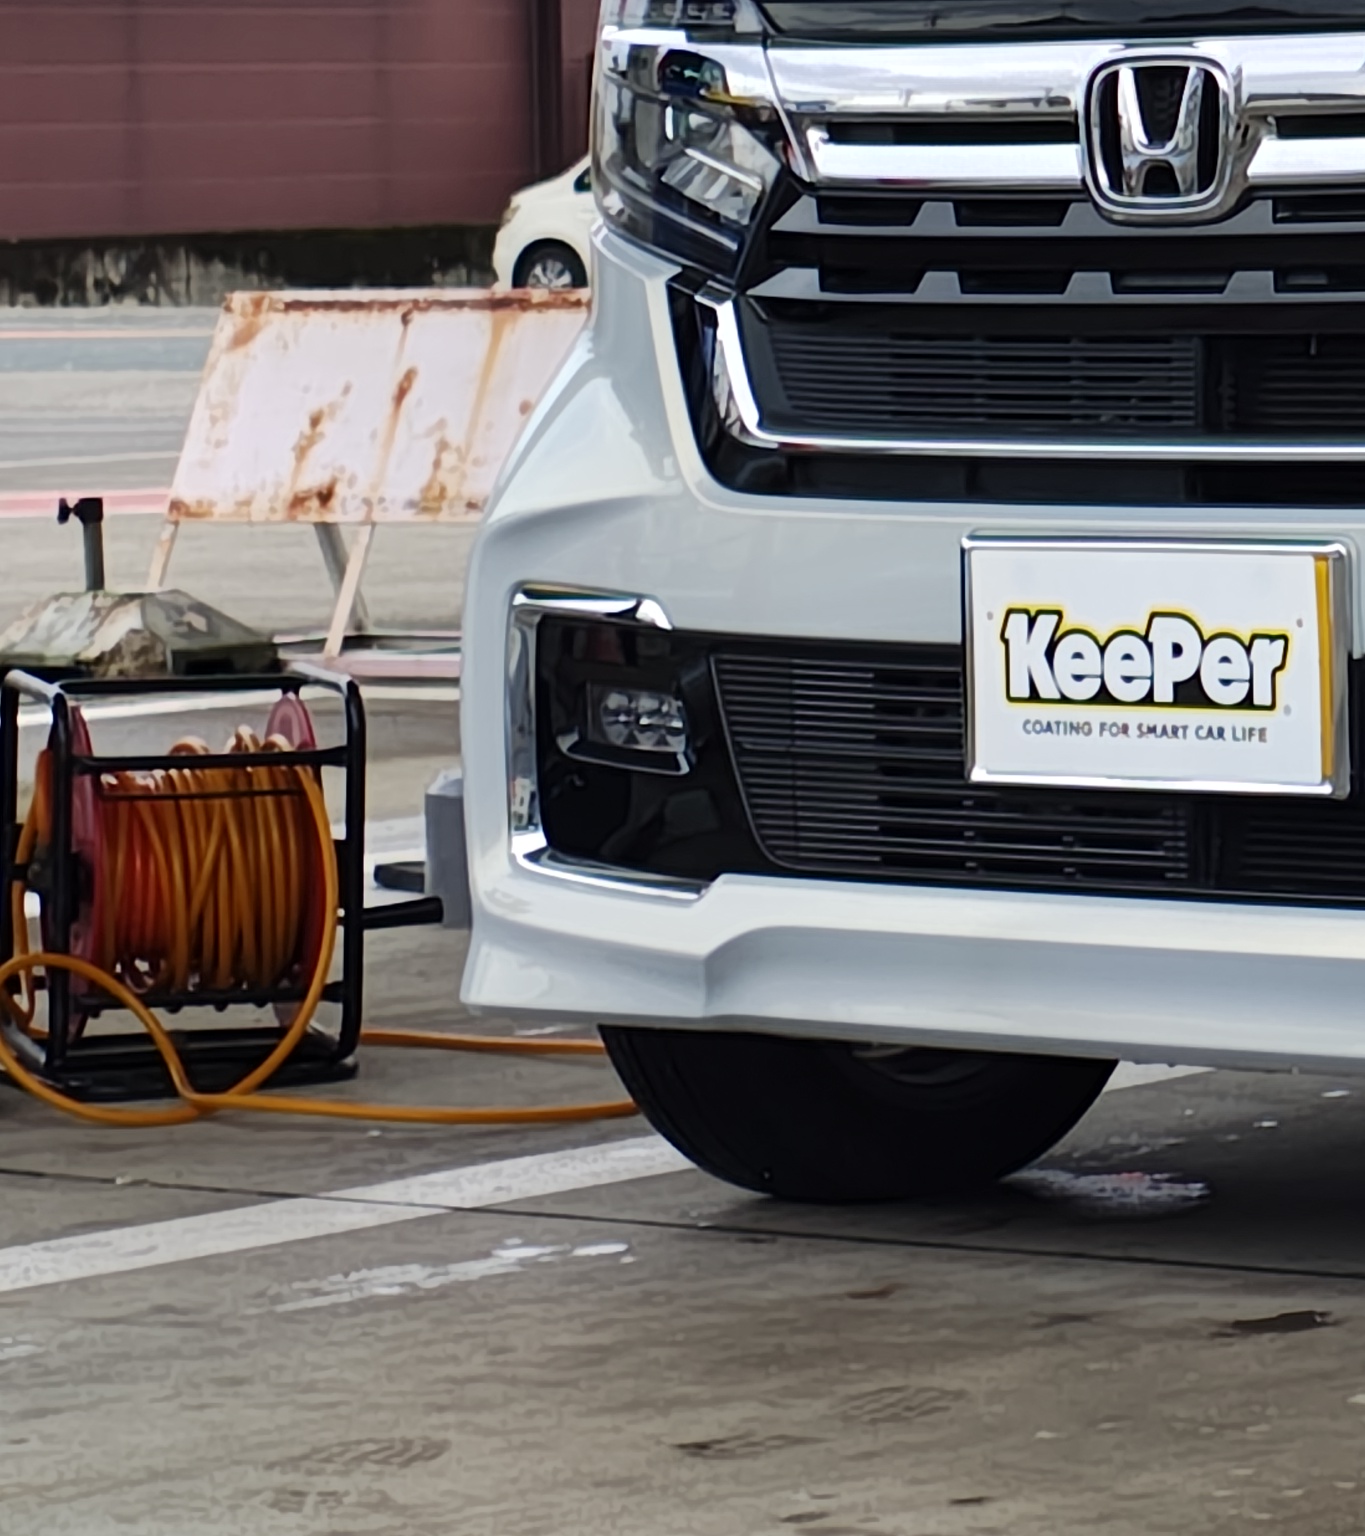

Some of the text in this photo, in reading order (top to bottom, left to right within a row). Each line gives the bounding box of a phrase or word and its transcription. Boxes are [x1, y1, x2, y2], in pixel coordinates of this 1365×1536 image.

[1001, 606, 1288, 713] KeePer
[1022, 718, 1268, 743] COATING FOR SMART CAR LIFE
